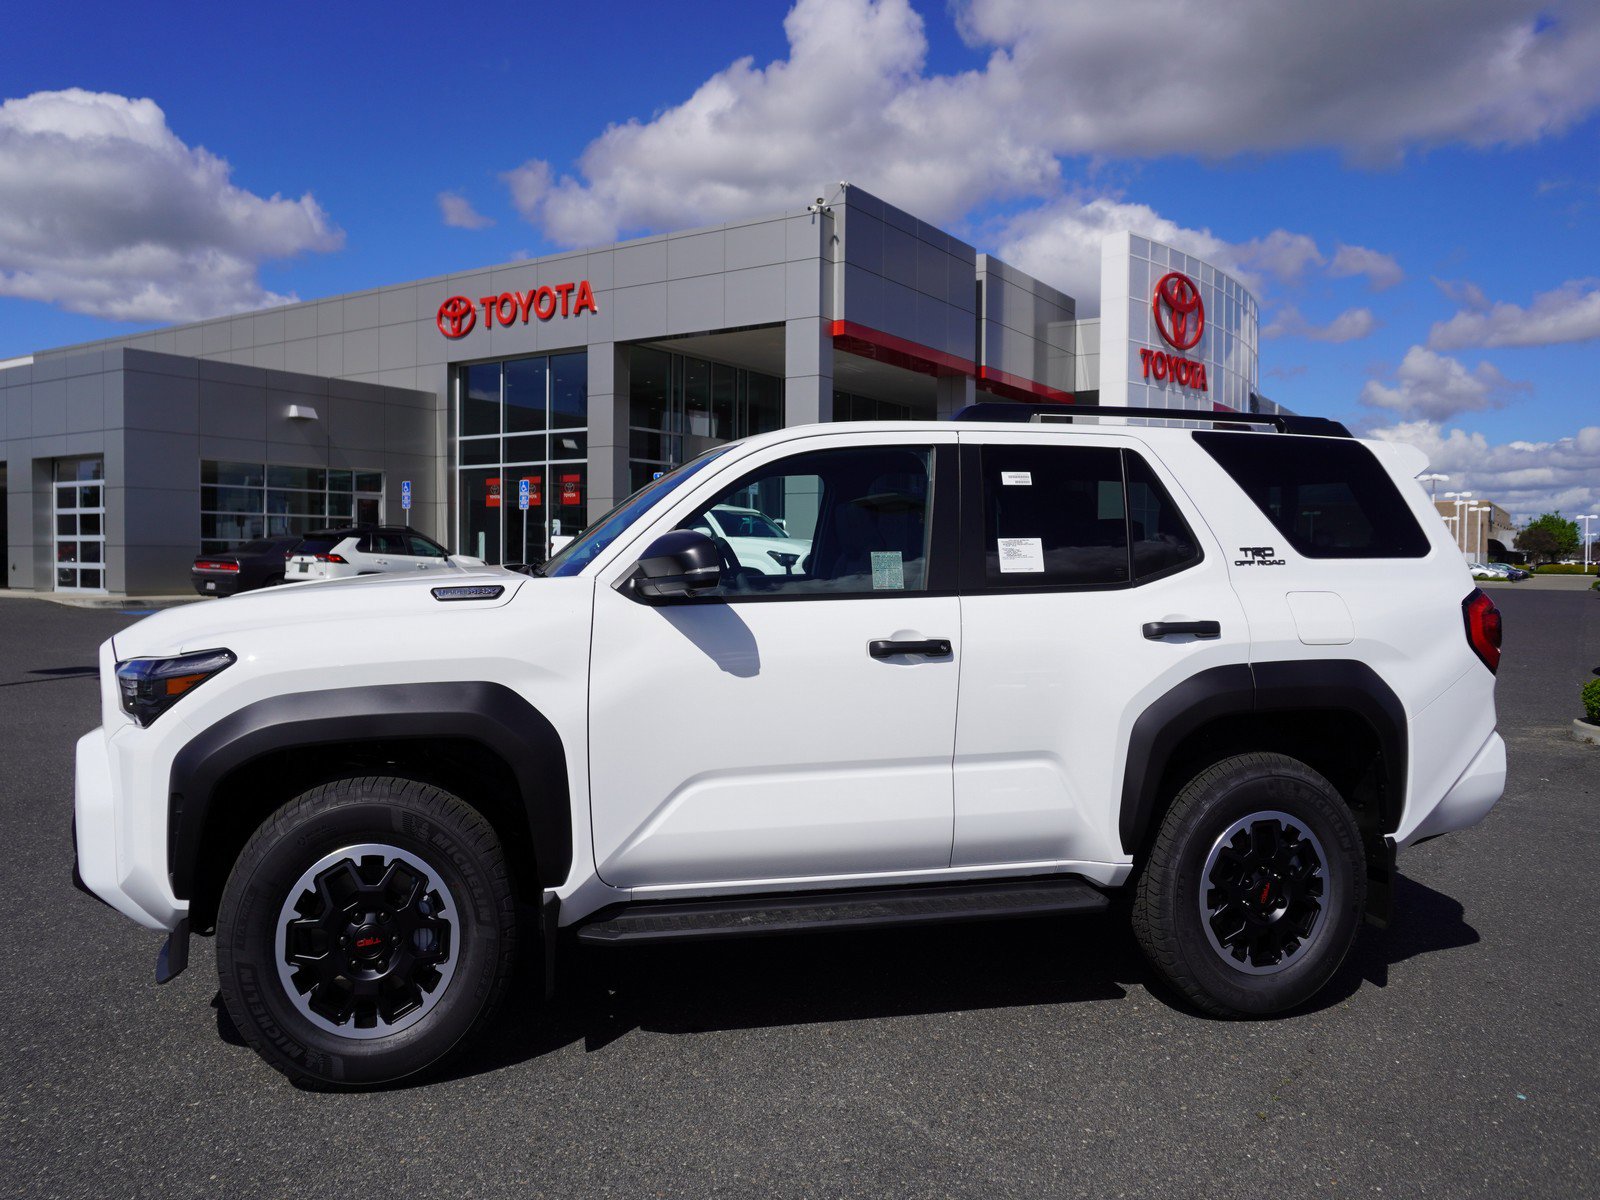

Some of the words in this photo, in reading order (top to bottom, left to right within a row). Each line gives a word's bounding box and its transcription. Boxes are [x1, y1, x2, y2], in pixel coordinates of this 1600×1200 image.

[480, 280, 597, 329] TOYOTA
[1140, 348, 1208, 391] TOYOTA
[1239, 547, 1275, 560] TRD
[239, 967, 304, 1059] MICHELIN
